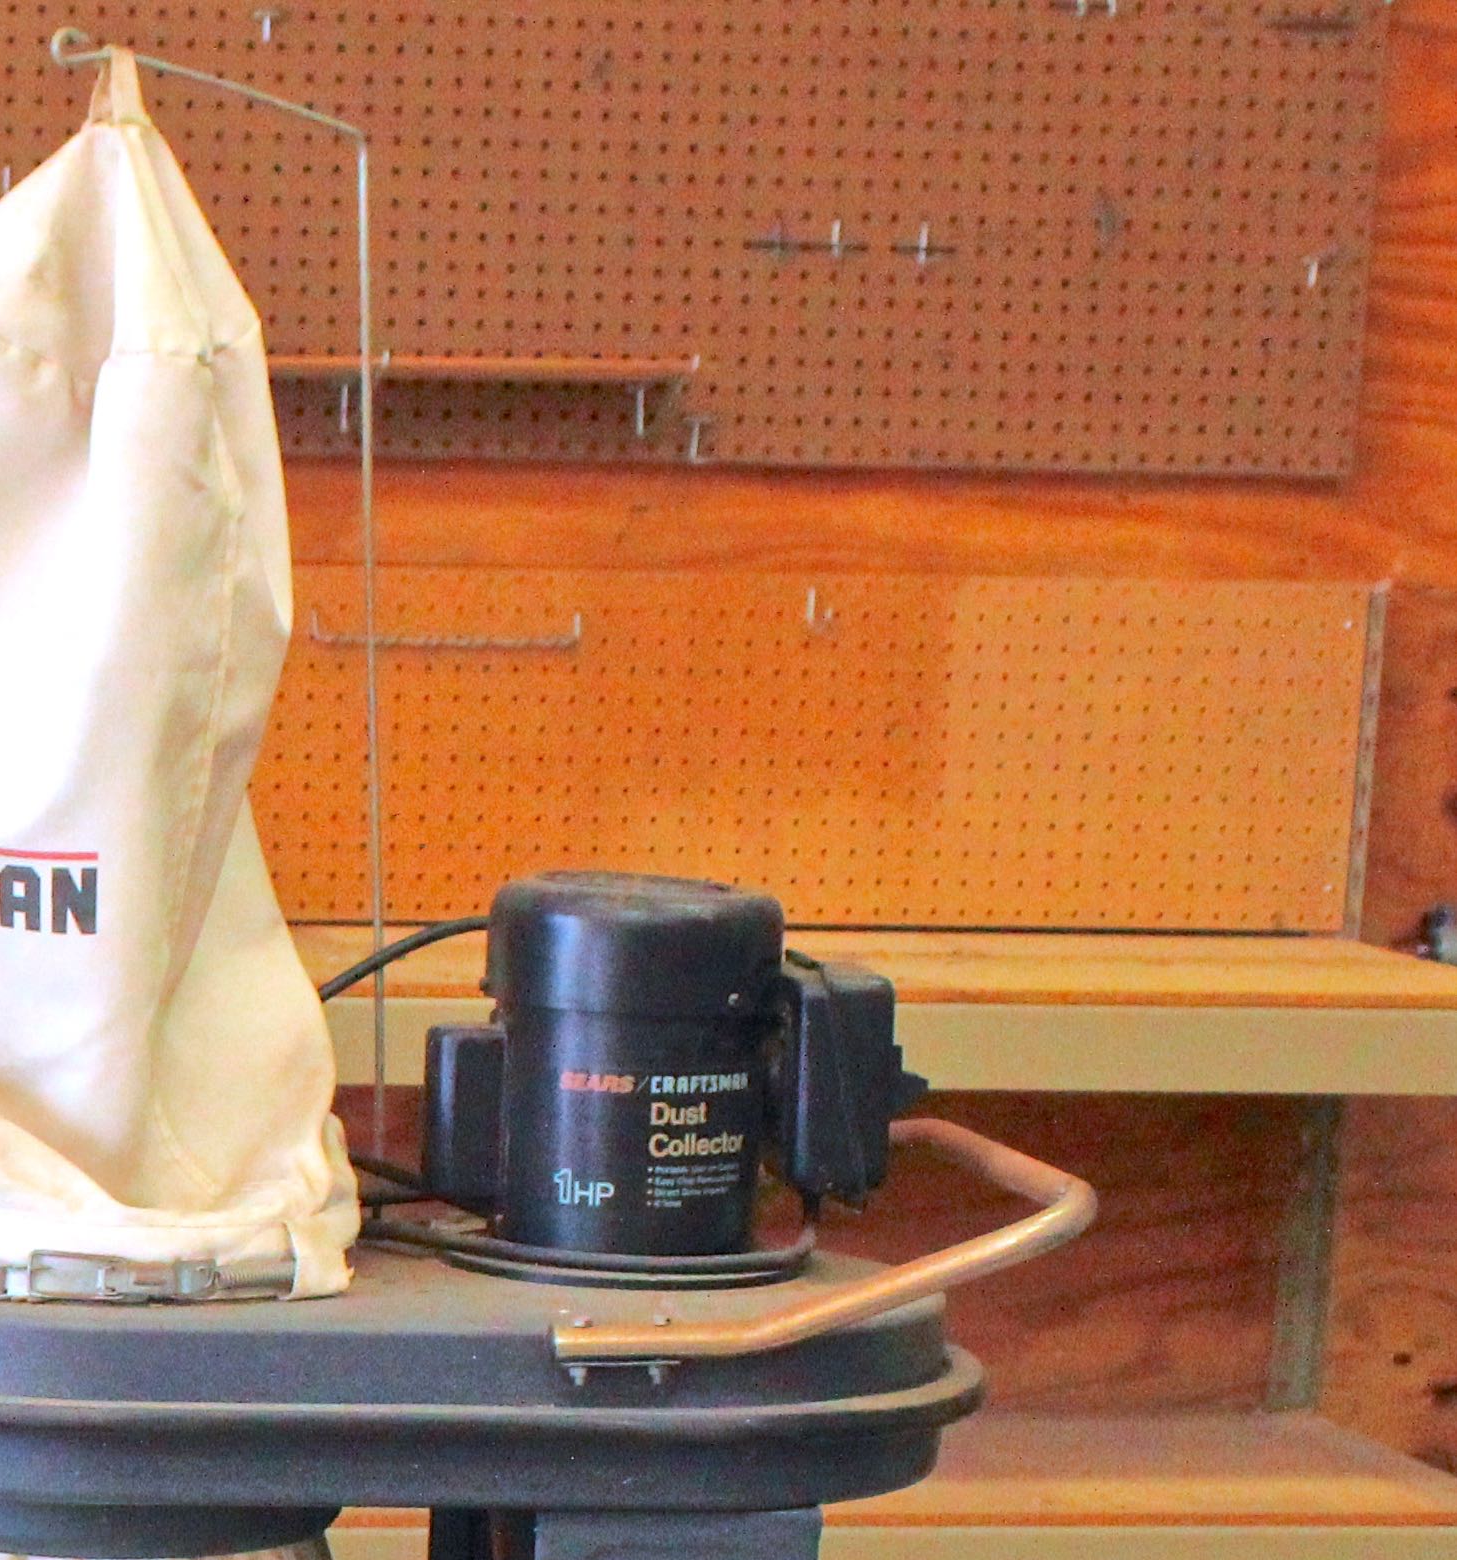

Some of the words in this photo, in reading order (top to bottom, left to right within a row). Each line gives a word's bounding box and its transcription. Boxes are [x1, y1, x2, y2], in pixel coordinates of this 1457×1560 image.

[650, 1072, 749, 1094] CRAFTSMAN
[650, 1101, 707, 1126] Dust
[648, 1131, 745, 1158] Collector
